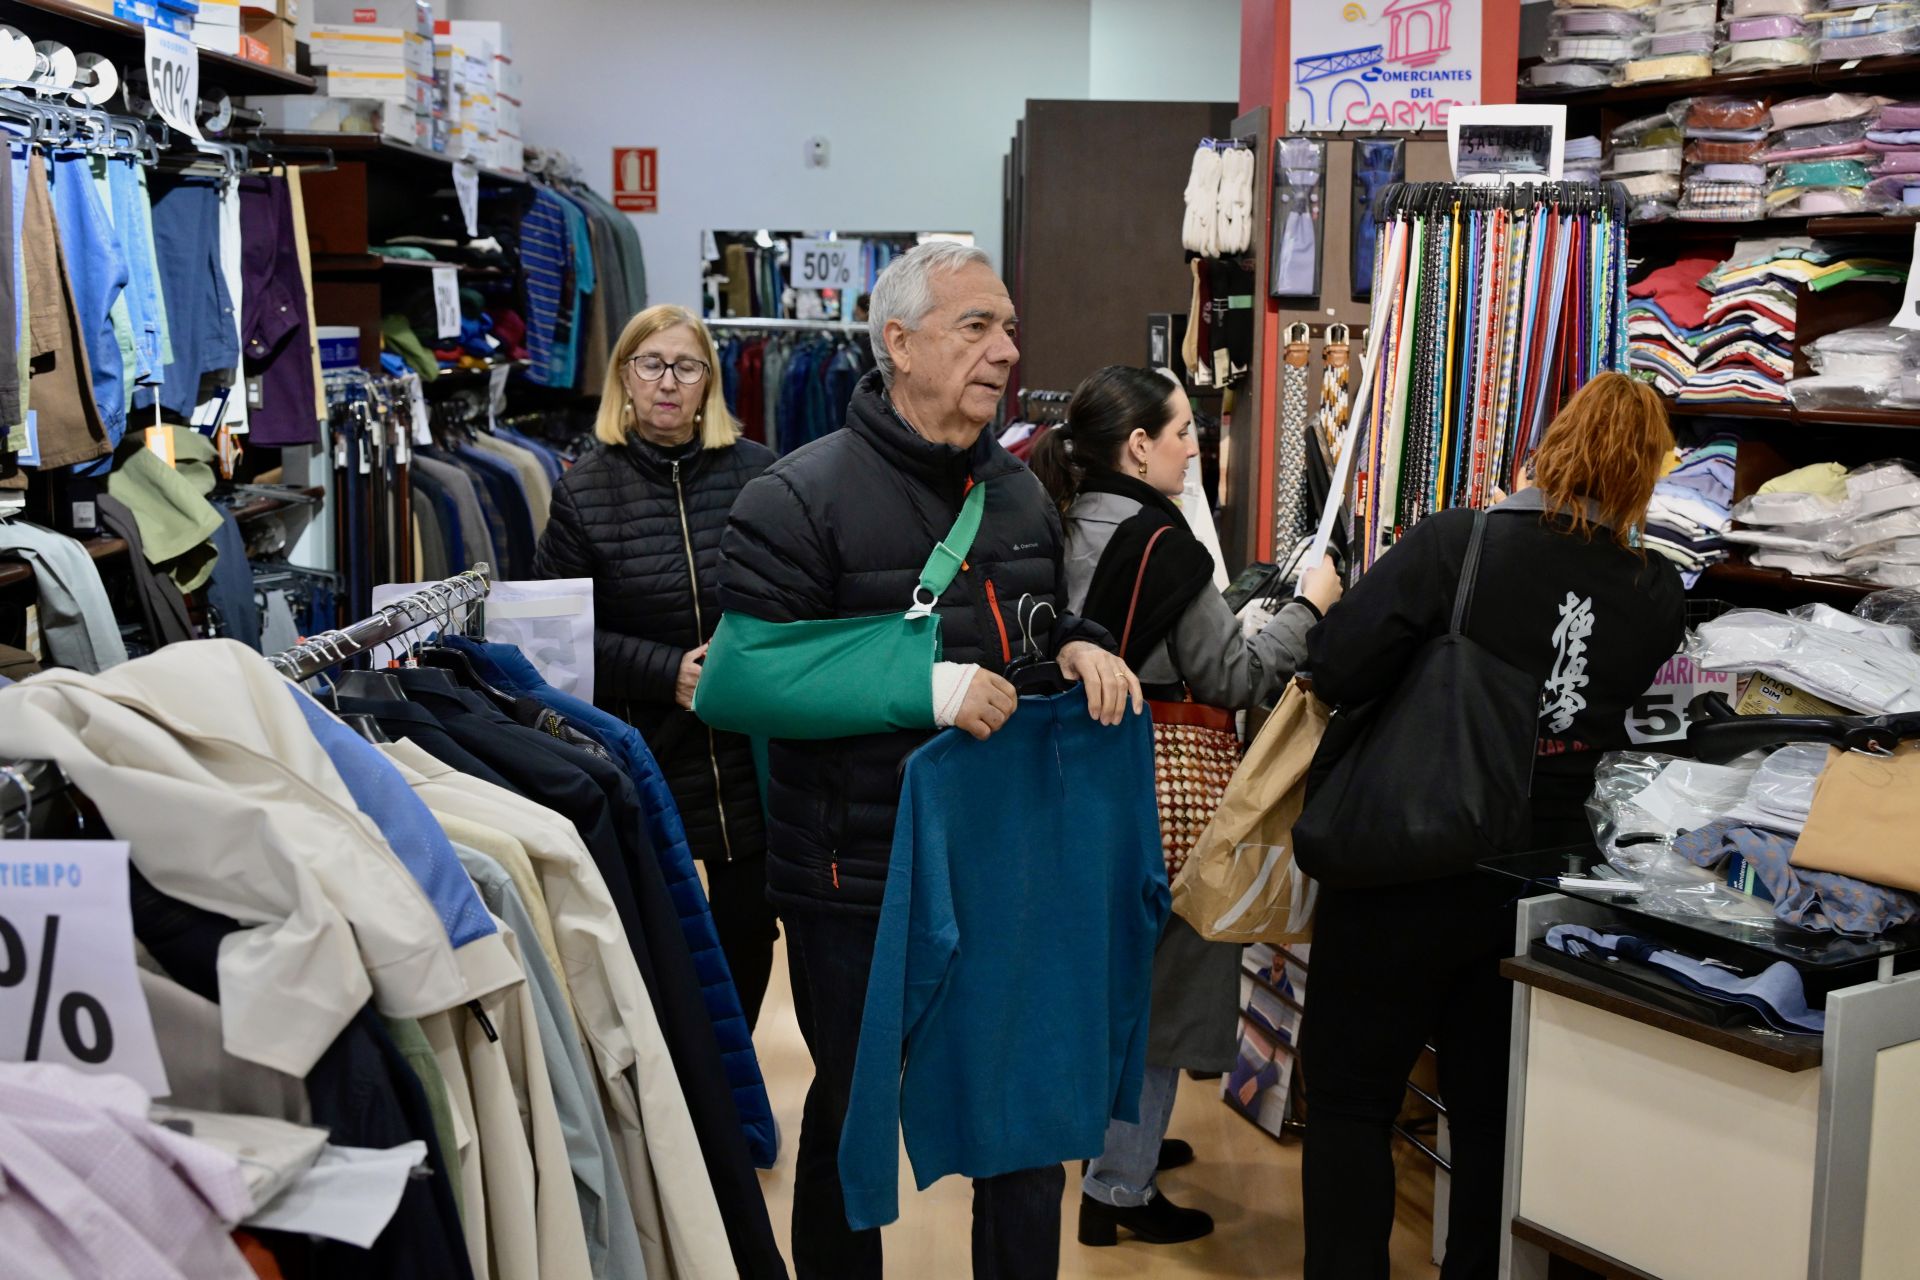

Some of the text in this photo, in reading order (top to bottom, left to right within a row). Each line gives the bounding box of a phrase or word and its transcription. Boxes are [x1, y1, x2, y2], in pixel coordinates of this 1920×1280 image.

[1360, 66, 1472, 82] COMERCIANTES
[152, 56, 192, 127] 50%
[1411, 87, 1434, 99] DEL
[1346, 98, 1476, 126] CARME
[803, 251, 850, 283] 50%
[1761, 686, 1781, 701] DIM
